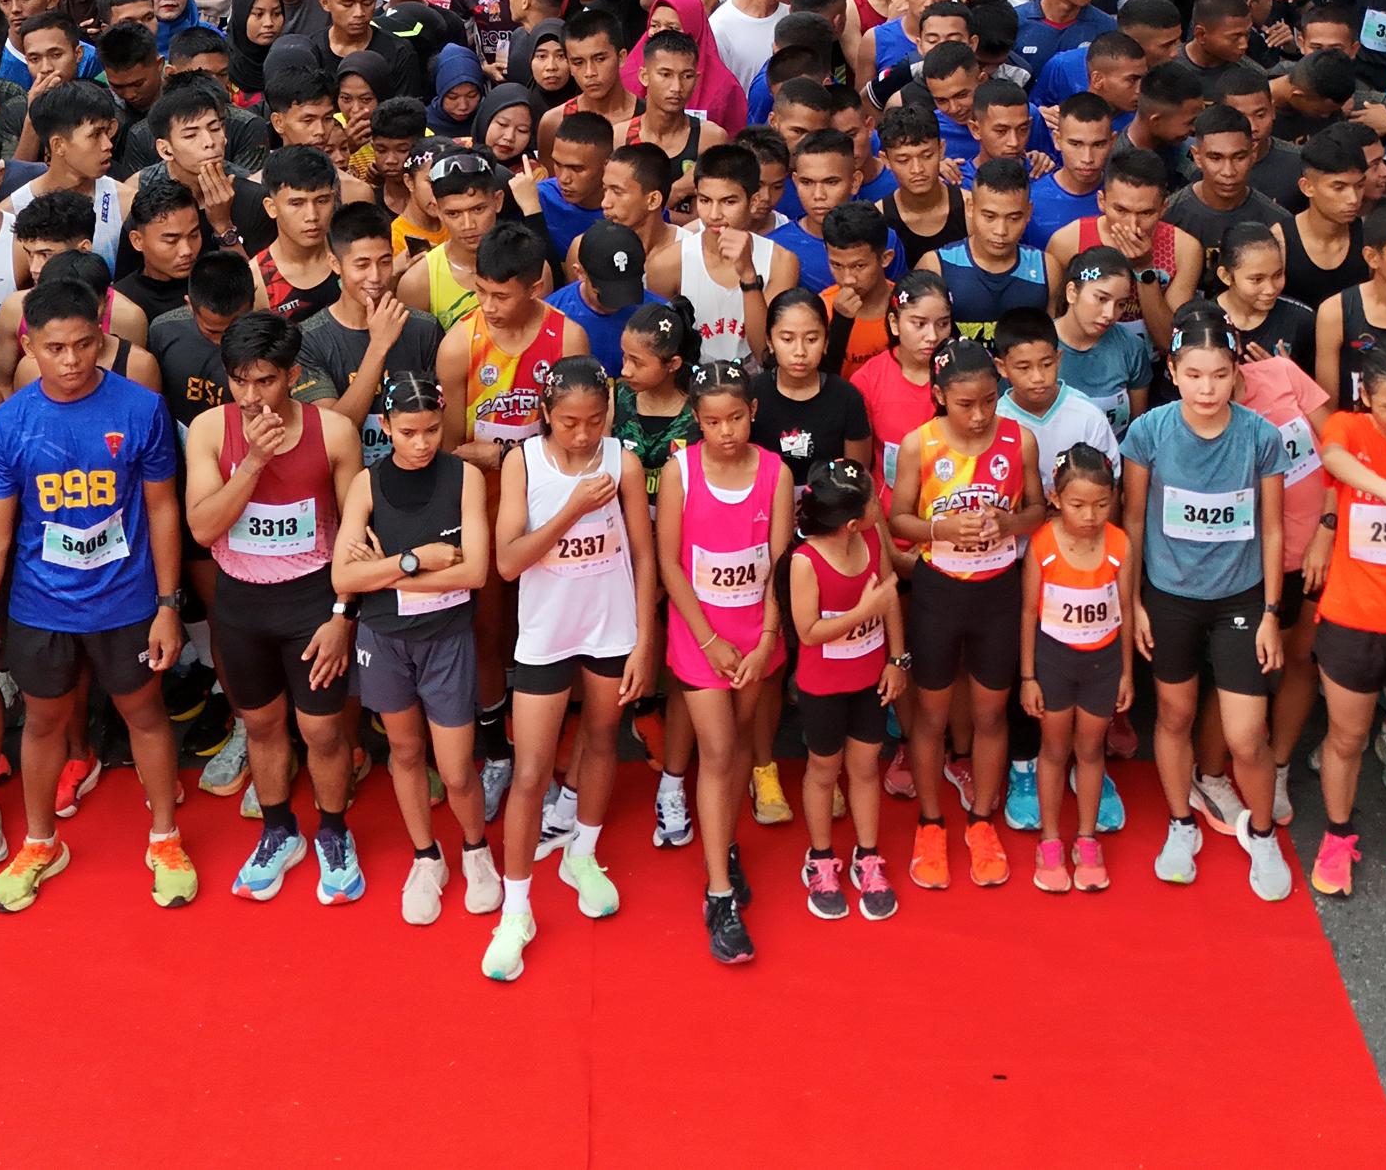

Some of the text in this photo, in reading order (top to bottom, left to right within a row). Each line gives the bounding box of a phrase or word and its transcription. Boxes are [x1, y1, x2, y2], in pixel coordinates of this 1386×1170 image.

[35, 469, 117, 512] 898
[932, 490, 1011, 516] SATRIA
[1183, 504, 1235, 524] 3426
[248, 516, 298, 538] 3313
[62, 529, 110, 557] 5408
[558, 534, 606, 558] 2337
[712, 562, 758, 587] 2324
[1062, 602, 1107, 623] 2169
